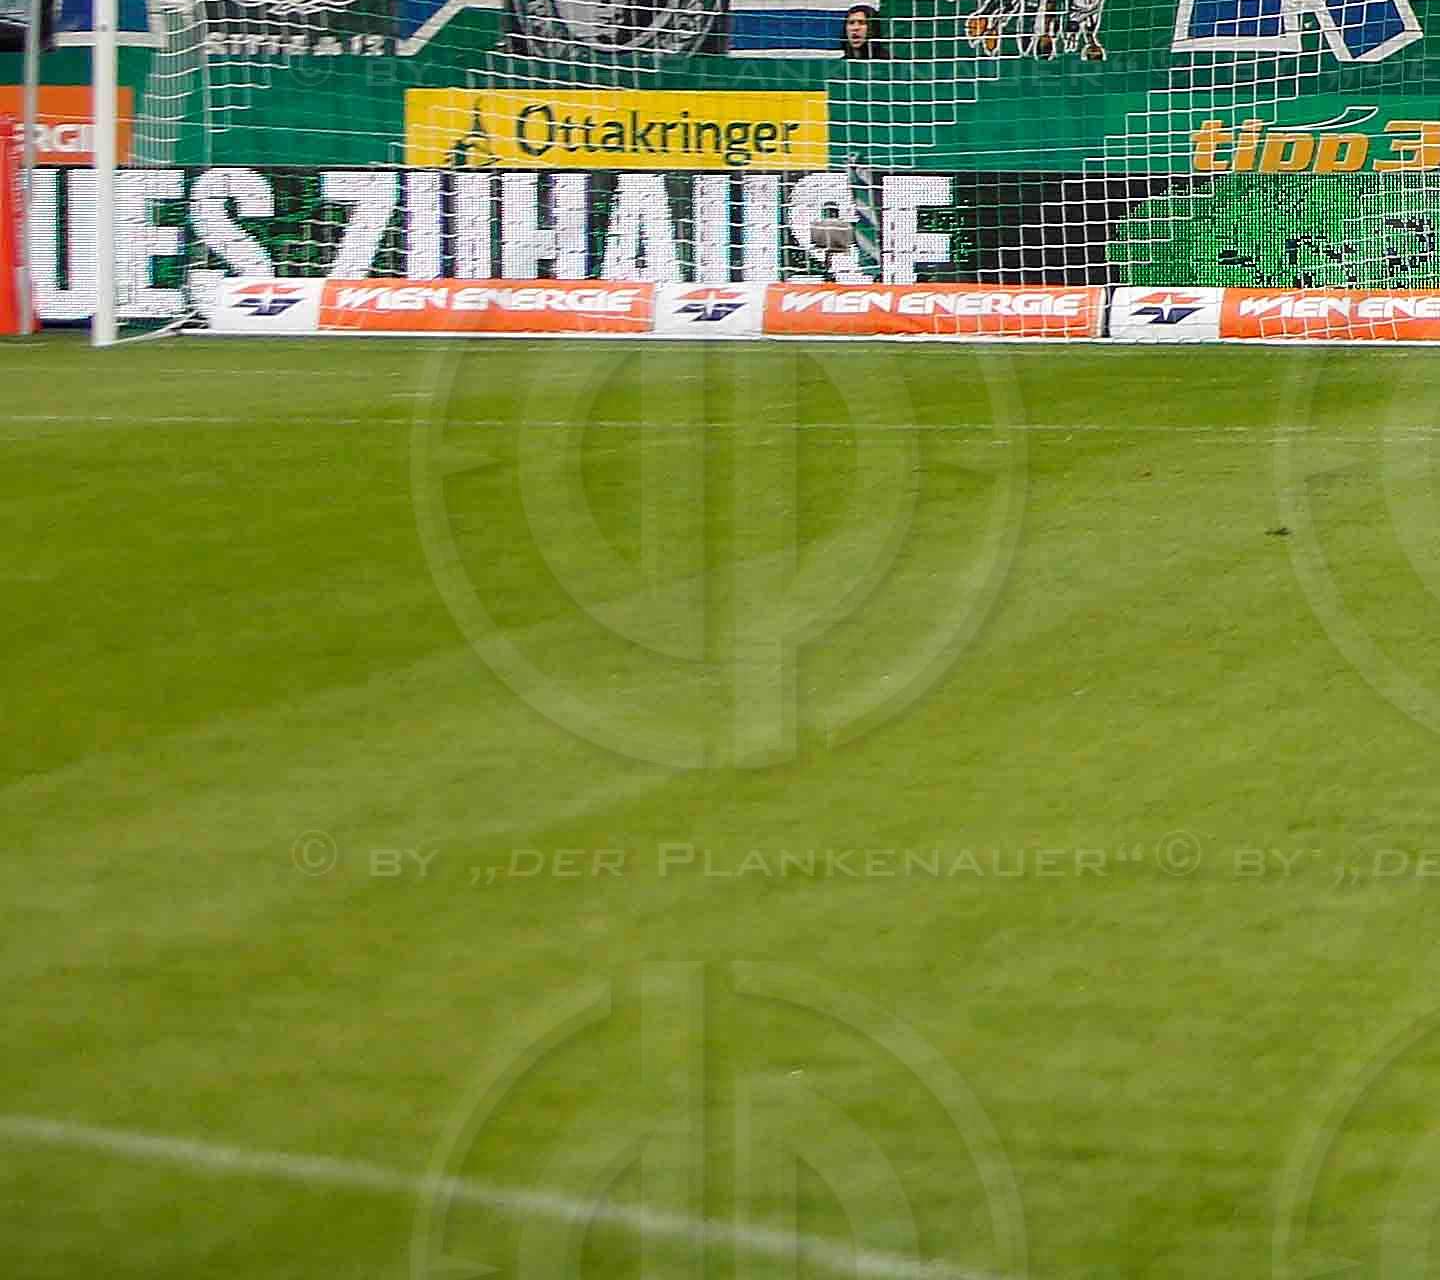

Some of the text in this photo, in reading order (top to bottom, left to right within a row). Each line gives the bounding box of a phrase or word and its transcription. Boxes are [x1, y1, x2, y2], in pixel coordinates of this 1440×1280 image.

[516, 102, 800, 166] Ottakringer
[318, 172, 953, 284] ZUHAUSE
[334, 286, 638, 314] WIEN ENERGIE
[780, 289, 1083, 318] WIEN ENERGIE
[1239, 295, 1357, 319] WIEN
